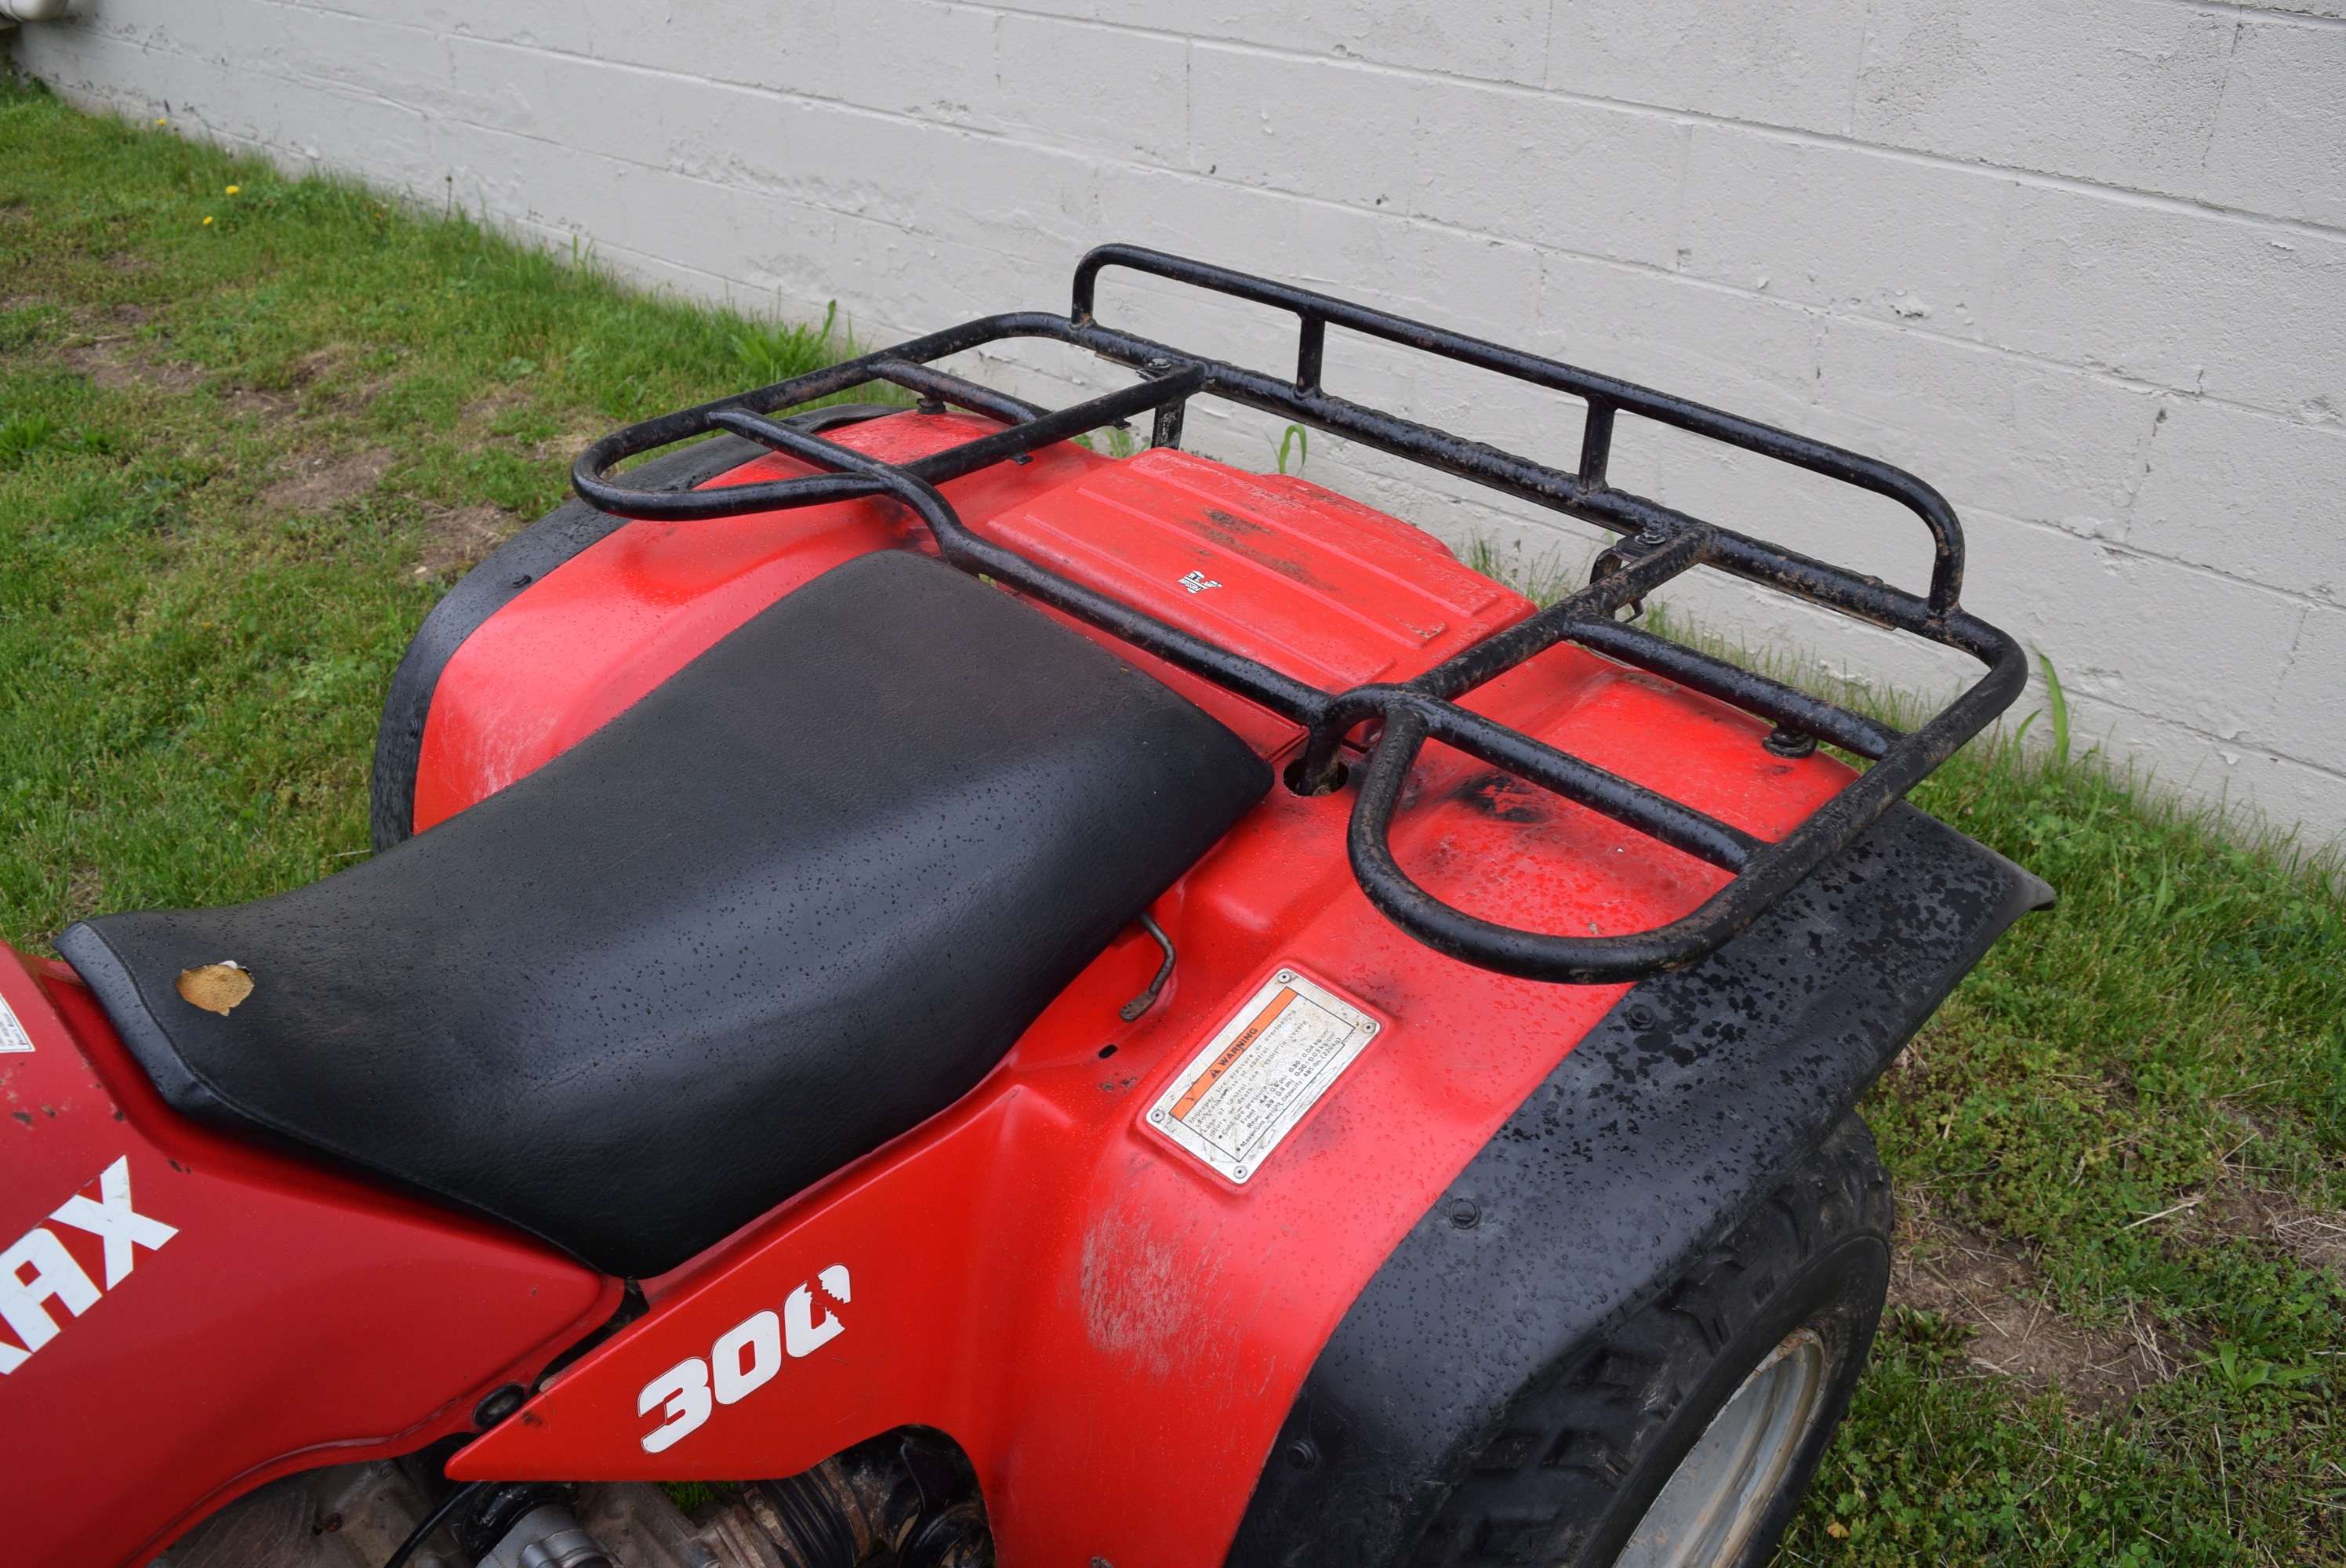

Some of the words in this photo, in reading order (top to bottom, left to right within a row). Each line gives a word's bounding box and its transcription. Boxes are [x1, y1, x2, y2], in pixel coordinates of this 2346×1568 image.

[1188, 1095, 1215, 1123] Improper
[1215, 1080, 1227, 1092] tire
[1228, 1053, 1254, 1079] pressure
[1263, 1008, 1296, 1042] overloading
[1217, 1025, 1258, 1067] WARNING
[1201, 1117, 1216, 1133] Loss
[1247, 1069, 1260, 1081] can
[1260, 1050, 1278, 1068] result
[1288, 1019, 1307, 1039] severe
[1278, 1074, 1288, 1083] psi
[1208, 1096, 1224, 1112] cause
[1221, 1121, 1235, 1135] Cold
[1233, 1109, 1245, 1120] tire
[1239, 1120, 1266, 1148] Maximum
[1263, 1100, 1284, 1120] weight
[1208, 1117, 1227, 1137] injury
[0, 1154, 180, 1374] AX
[638, 1263, 851, 1454] 300
